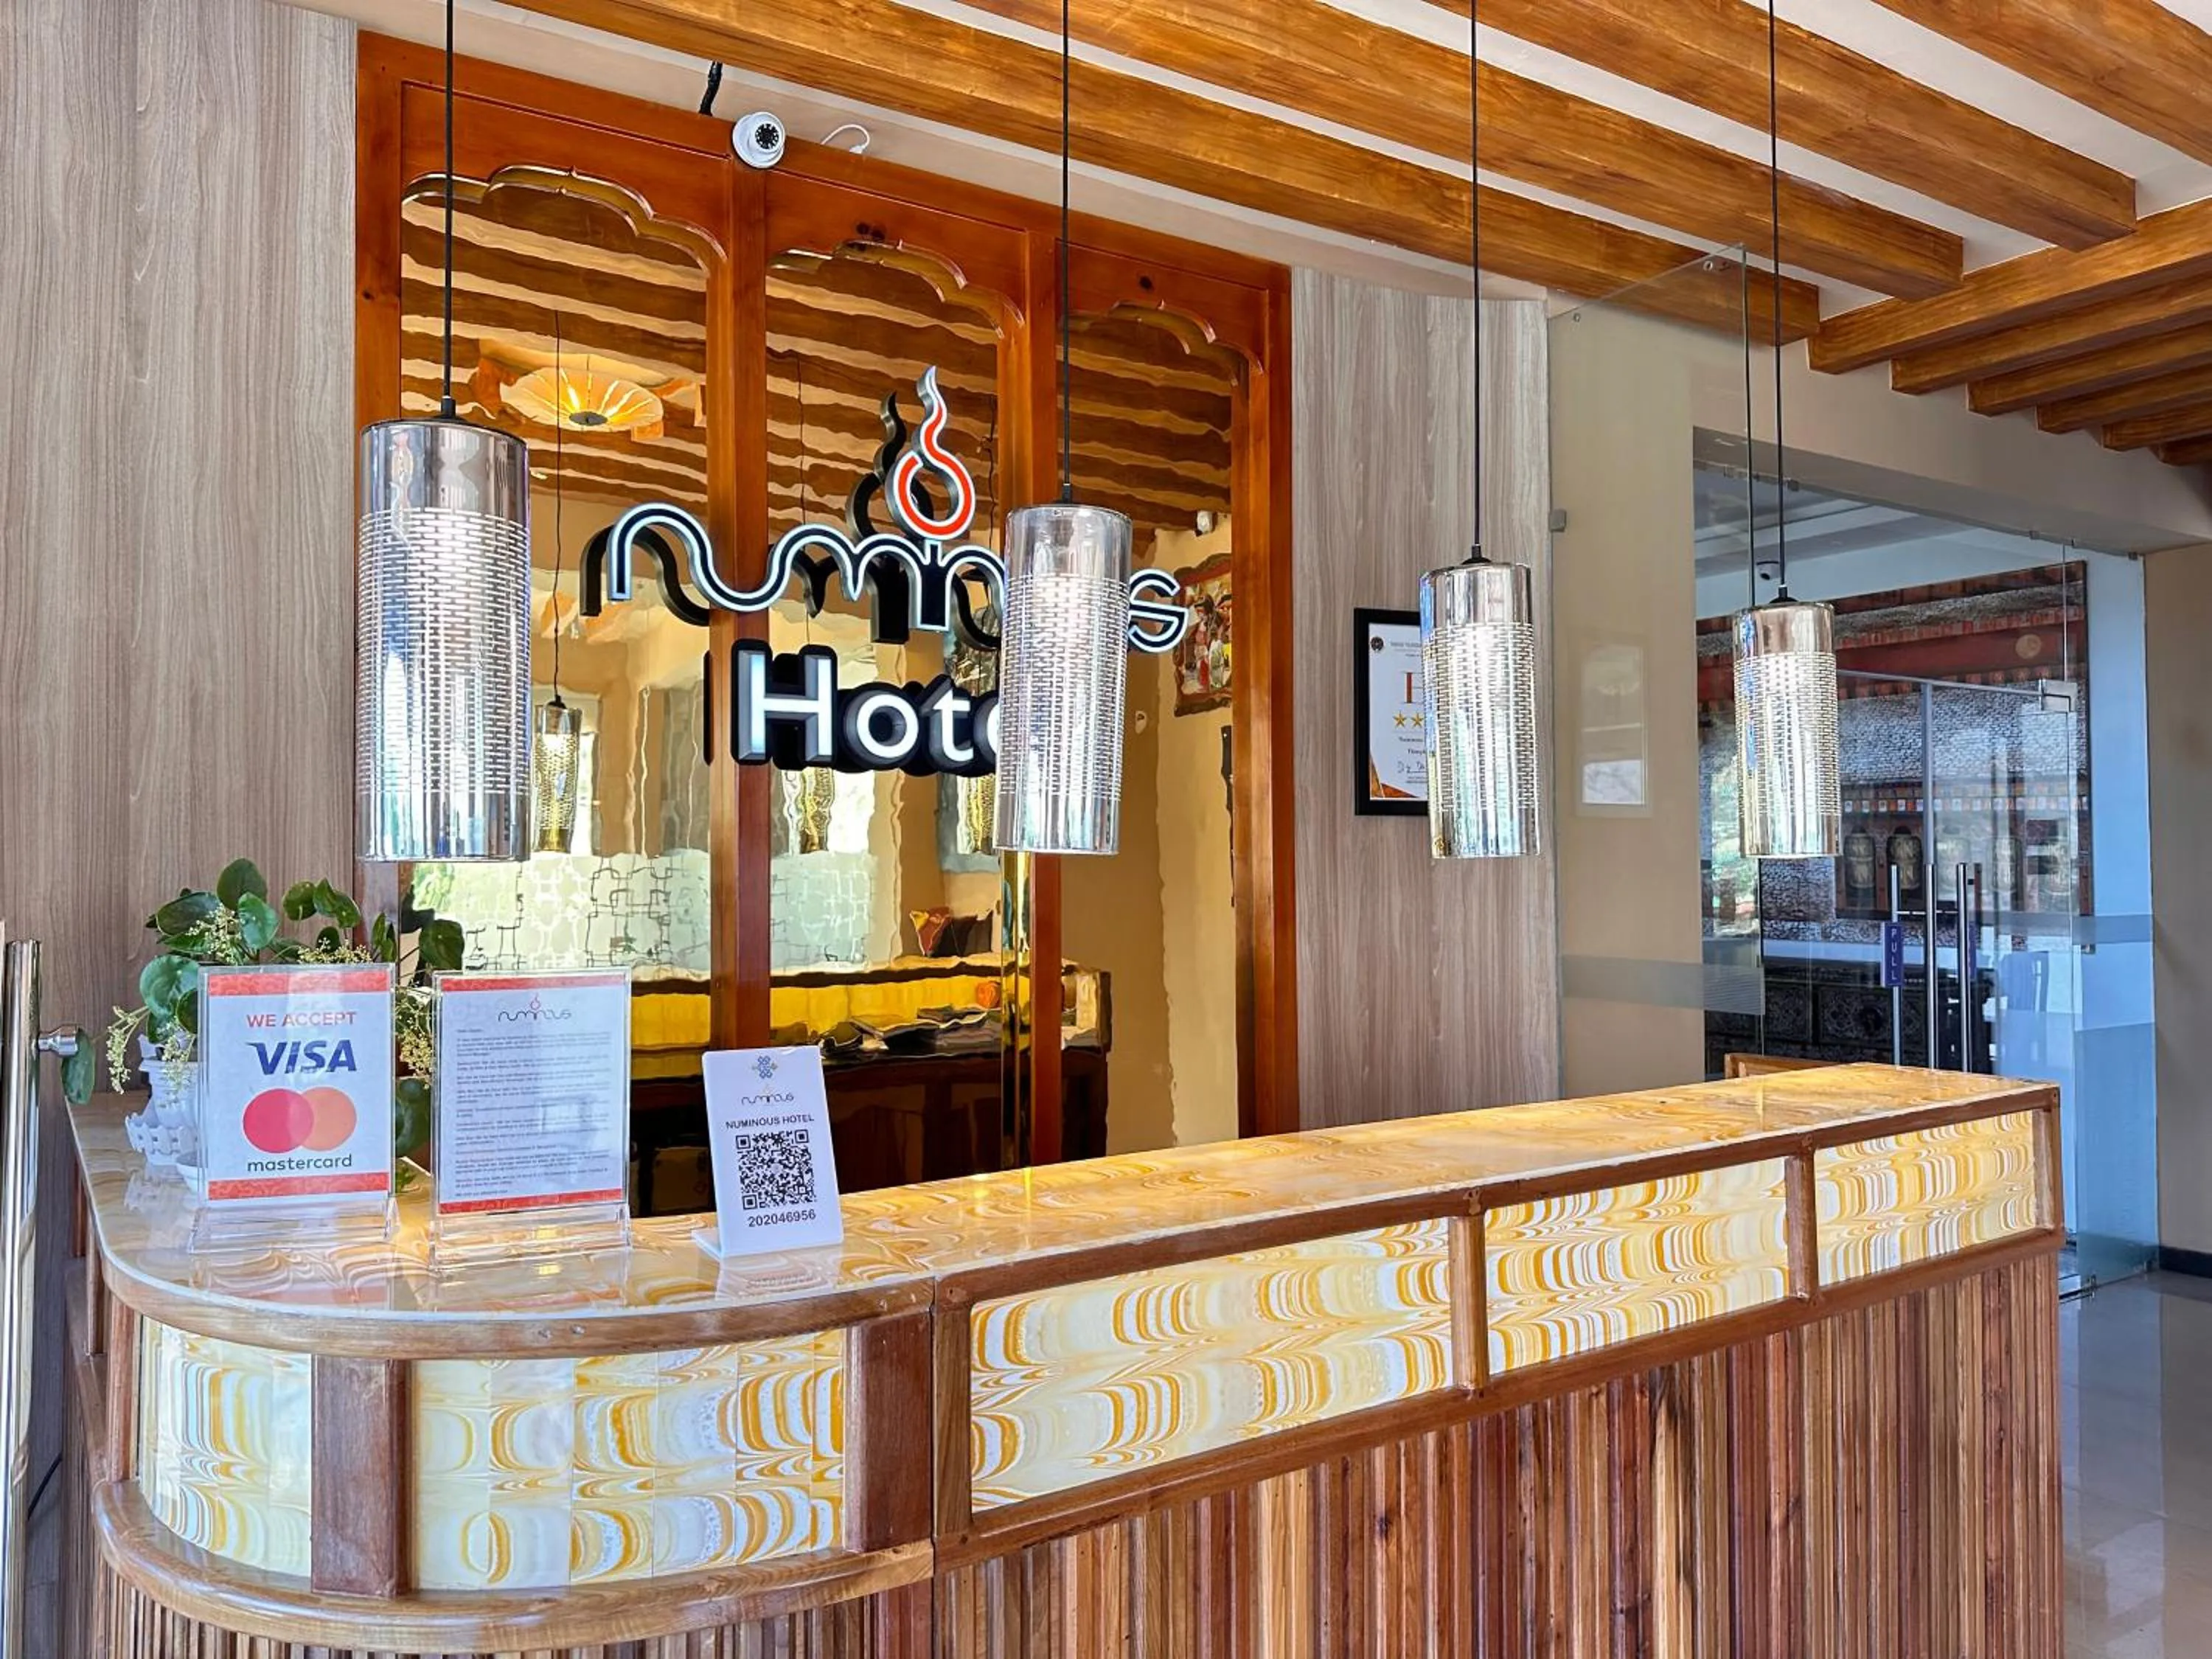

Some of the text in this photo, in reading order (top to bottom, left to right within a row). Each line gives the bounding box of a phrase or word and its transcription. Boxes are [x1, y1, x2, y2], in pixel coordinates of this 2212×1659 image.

[608, 503, 1189, 653] numins
[738, 648, 1001, 762] Hot
[247, 1012, 357, 1028] WE ACCEPT
[246, 1040, 358, 1075] VISA
[726, 1114, 815, 1130] NUMINOUS HOTEL
[247, 1154, 352, 1172] mastercard
[748, 1208, 816, 1228] 202046956
